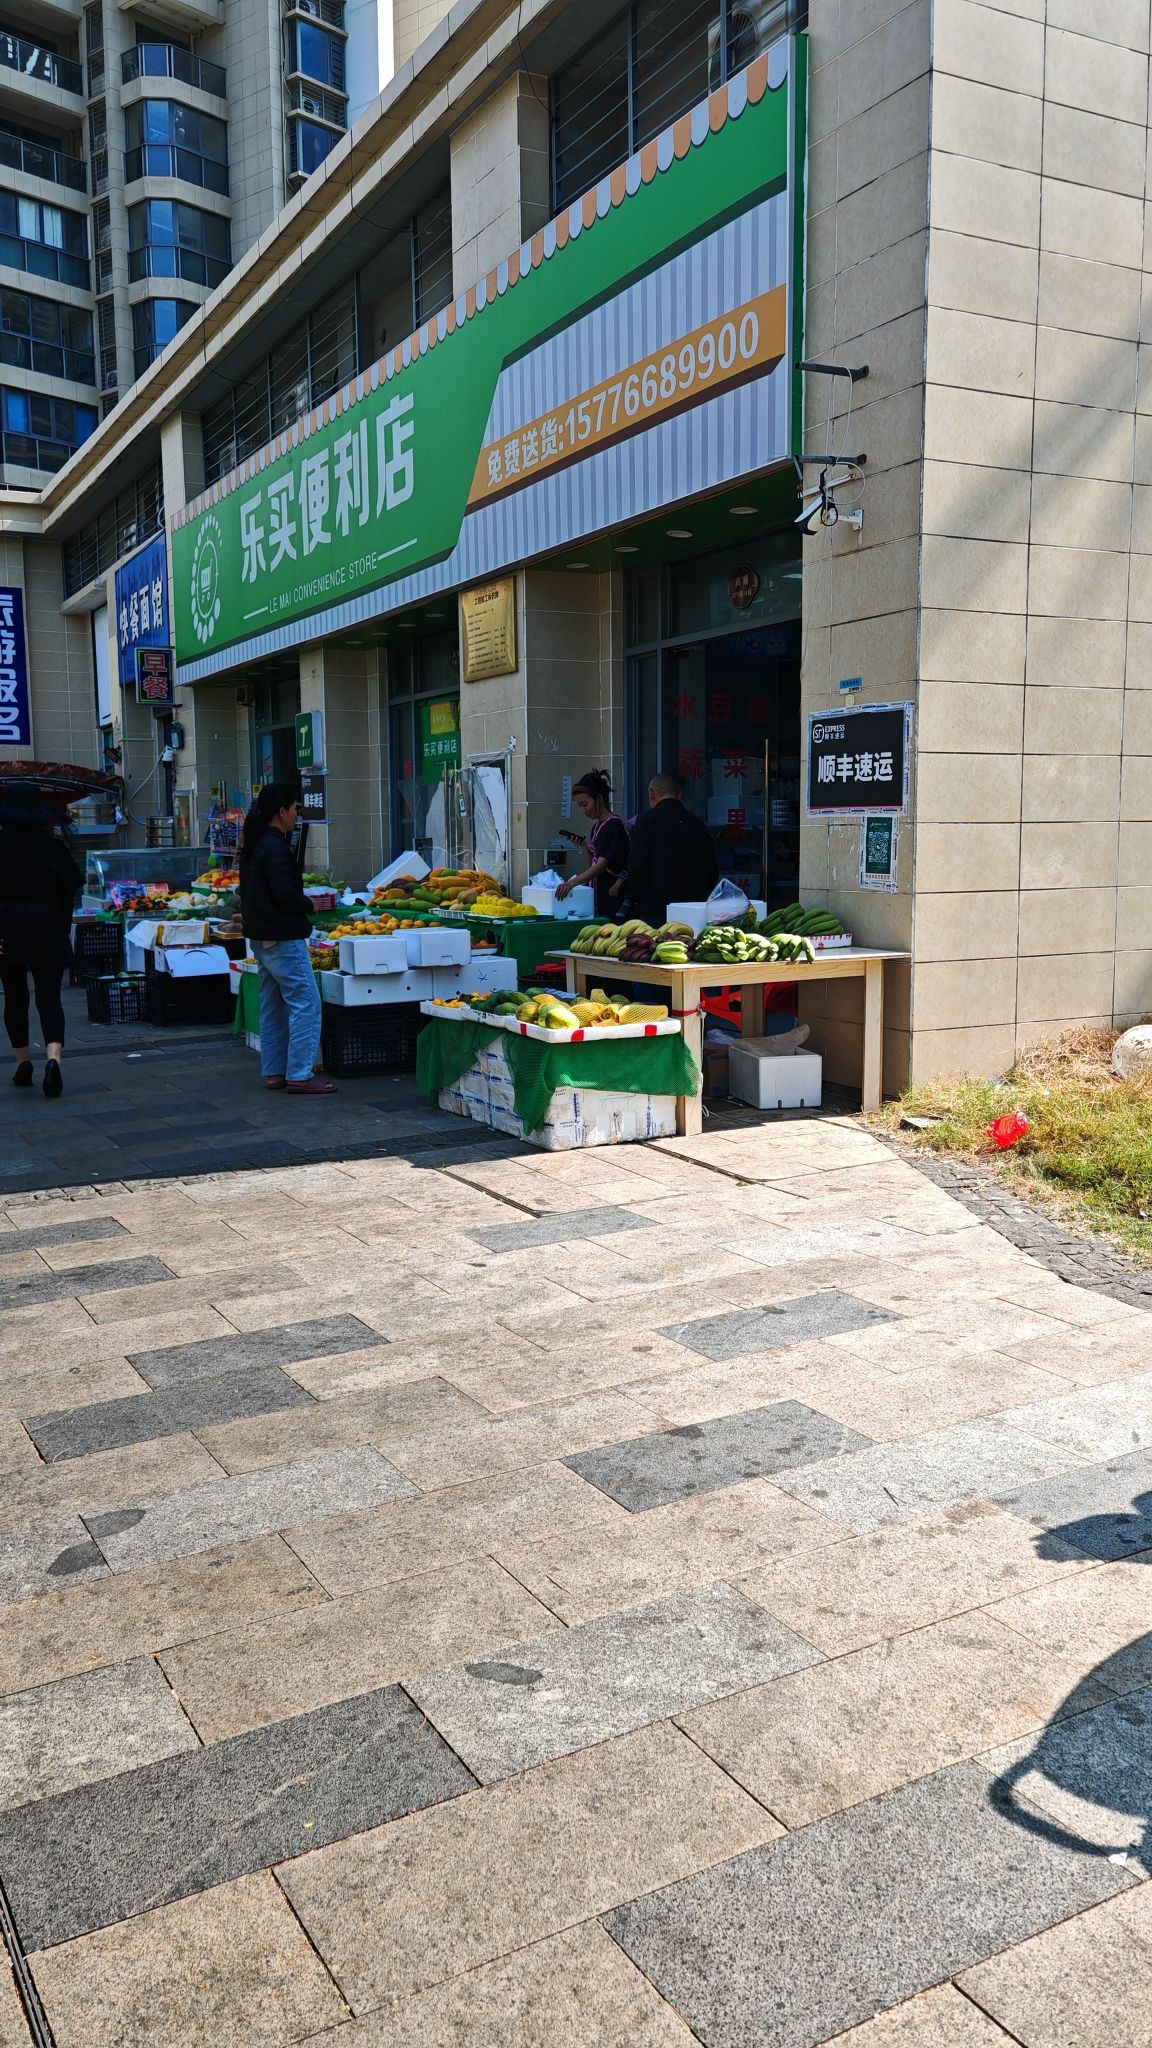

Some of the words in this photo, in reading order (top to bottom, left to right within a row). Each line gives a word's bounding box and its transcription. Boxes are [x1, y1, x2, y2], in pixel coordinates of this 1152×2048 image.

[487, 311, 759, 487] 免费送货:15776689900
[240, 392, 415, 583] 乐买便利店
[269, 597, 278, 614] LE
[279, 590, 292, 609] MAI
[293, 567, 346, 603] CONVENIENCE
[348, 551, 377, 580] STORE
[120, 576, 163, 649] 快餐面馆
[143, 653, 168, 699] 早餐
[423, 739, 457, 757] 乐买便利店
[825, 725, 845, 733] EXPRESS
[818, 752, 893, 783] 顺丰速运
